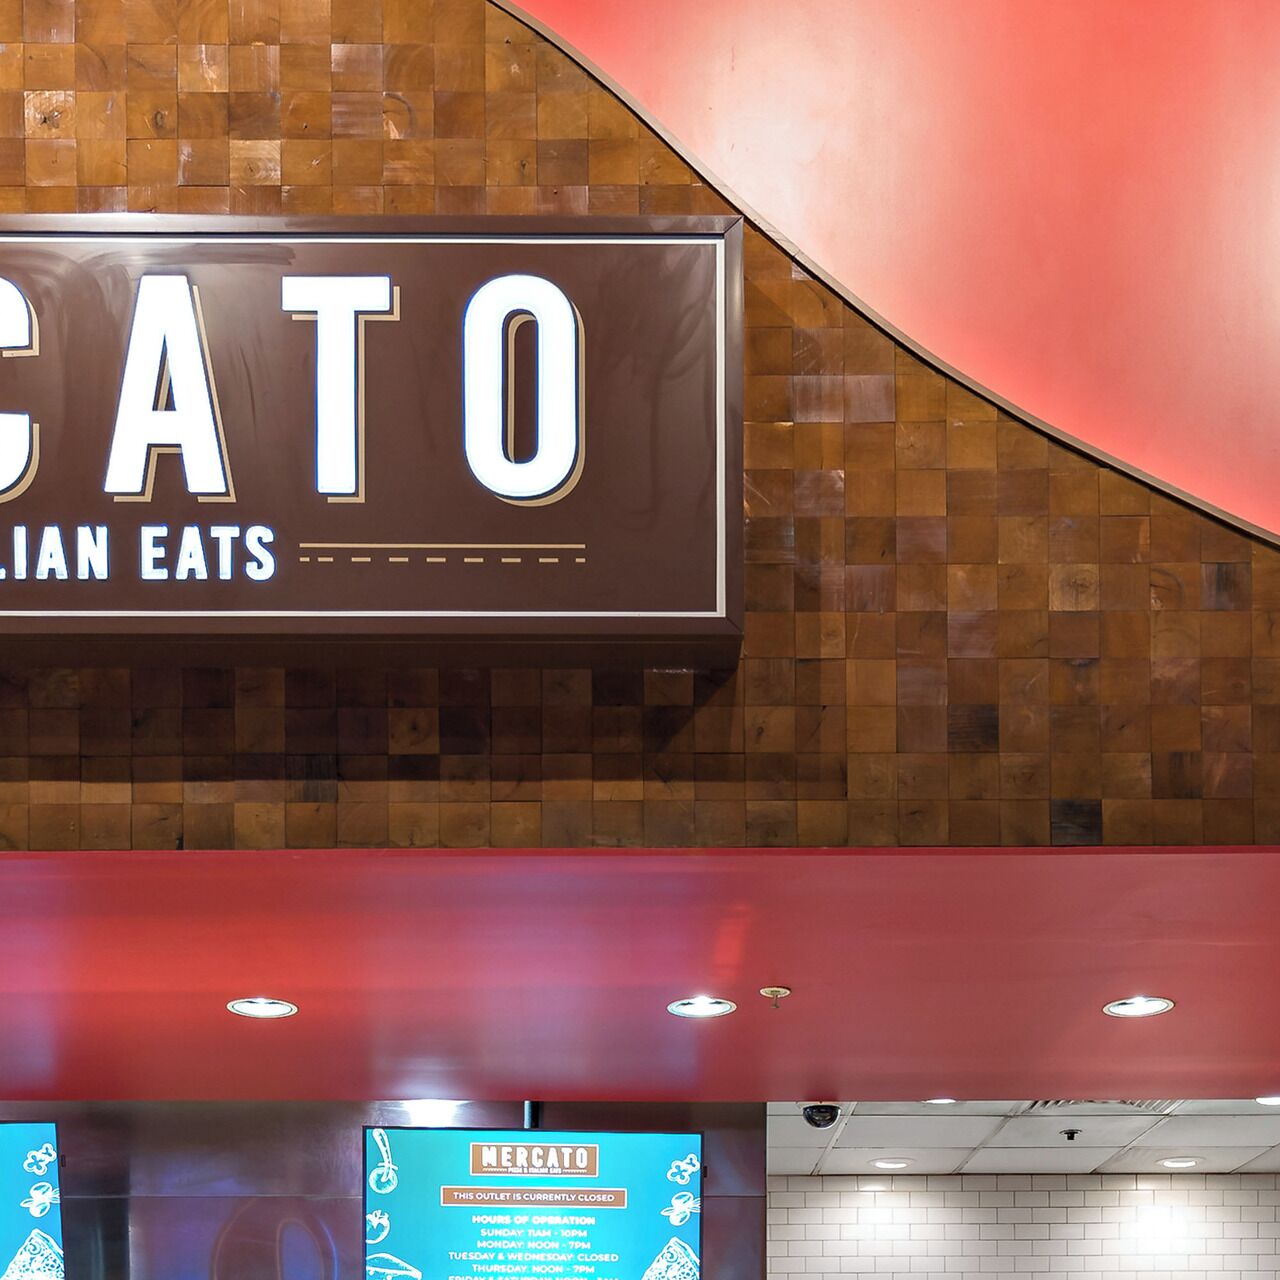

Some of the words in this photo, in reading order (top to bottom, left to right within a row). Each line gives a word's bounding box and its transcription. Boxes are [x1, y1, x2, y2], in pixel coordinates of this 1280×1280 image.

[140, 524, 276, 581] EATS
[481, 1146, 588, 1168] MERCATO
[476, 1192, 511, 1200] OUTLET
[523, 1193, 576, 1202] CURRENTLY
[578, 1194, 615, 1202] CLOSED
[472, 1216, 511, 1224] HOURS
[514, 1216, 528, 1224] OF
[532, 1216, 596, 1225] OPERATION
[528, 1229, 552, 1237] 11AM
[561, 1229, 588, 1237] 10PM
[528, 1241, 560, 1249] NOON
[568, 1241, 590, 1249] 7PM
[448, 1252, 495, 1260] TUESDAY
[577, 1254, 618, 1262] CLOSED
[532, 1265, 564, 1273] NOON
[573, 1265, 595, 1273] 7PM
